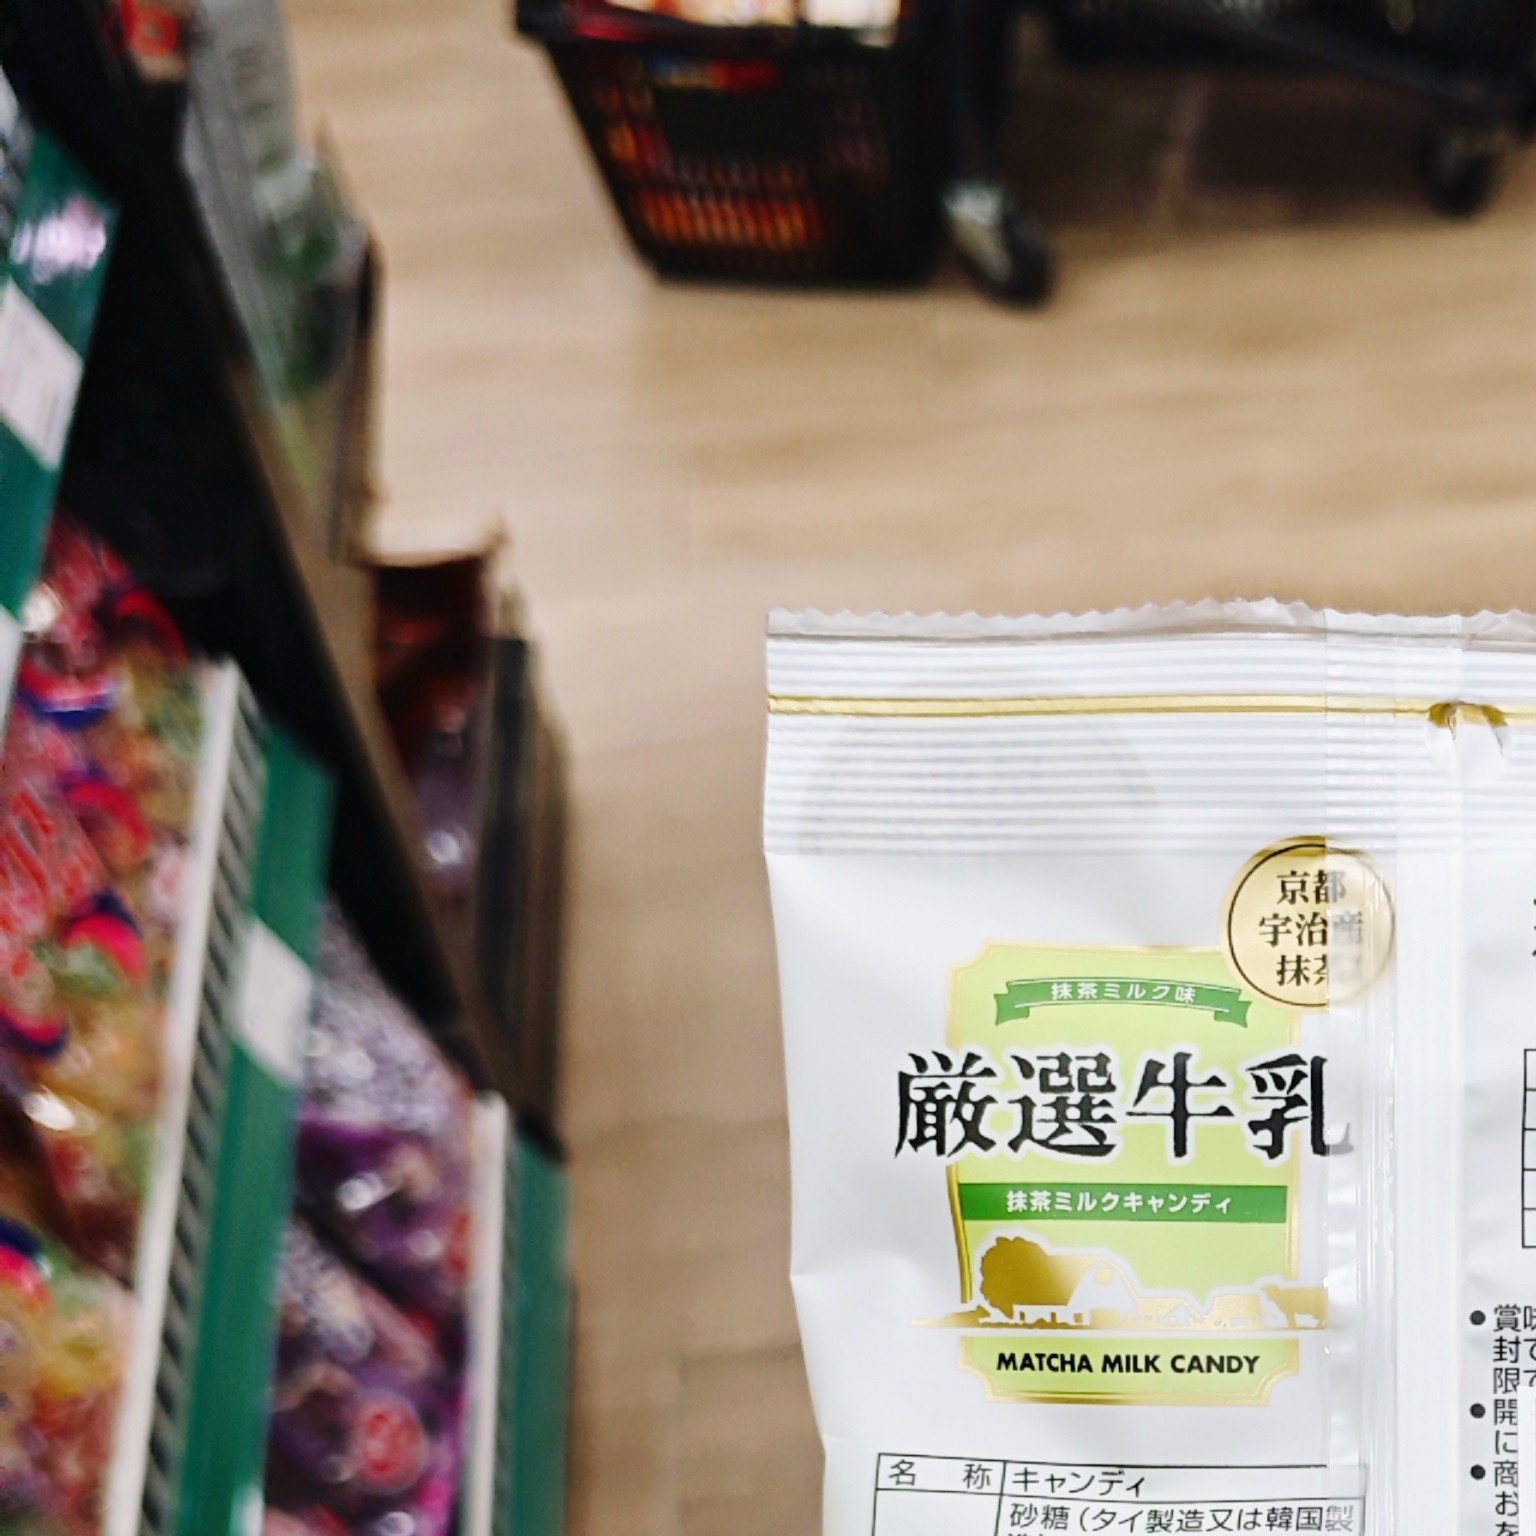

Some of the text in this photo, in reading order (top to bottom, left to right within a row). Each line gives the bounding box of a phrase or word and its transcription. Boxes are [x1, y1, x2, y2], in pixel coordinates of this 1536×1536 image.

[1277, 870, 1346, 905] 京都
[1051, 980, 1196, 1005] 抹茶ミルク味
[894, 1050, 1355, 1159] 厳選牛乳
[1006, 1191, 1231, 1214] 抹茶ミルクキャンディ
[997, 1352, 1260, 1375] MATCHA MILK CANDY
[1012, 1471, 1147, 1497] キャンディ
